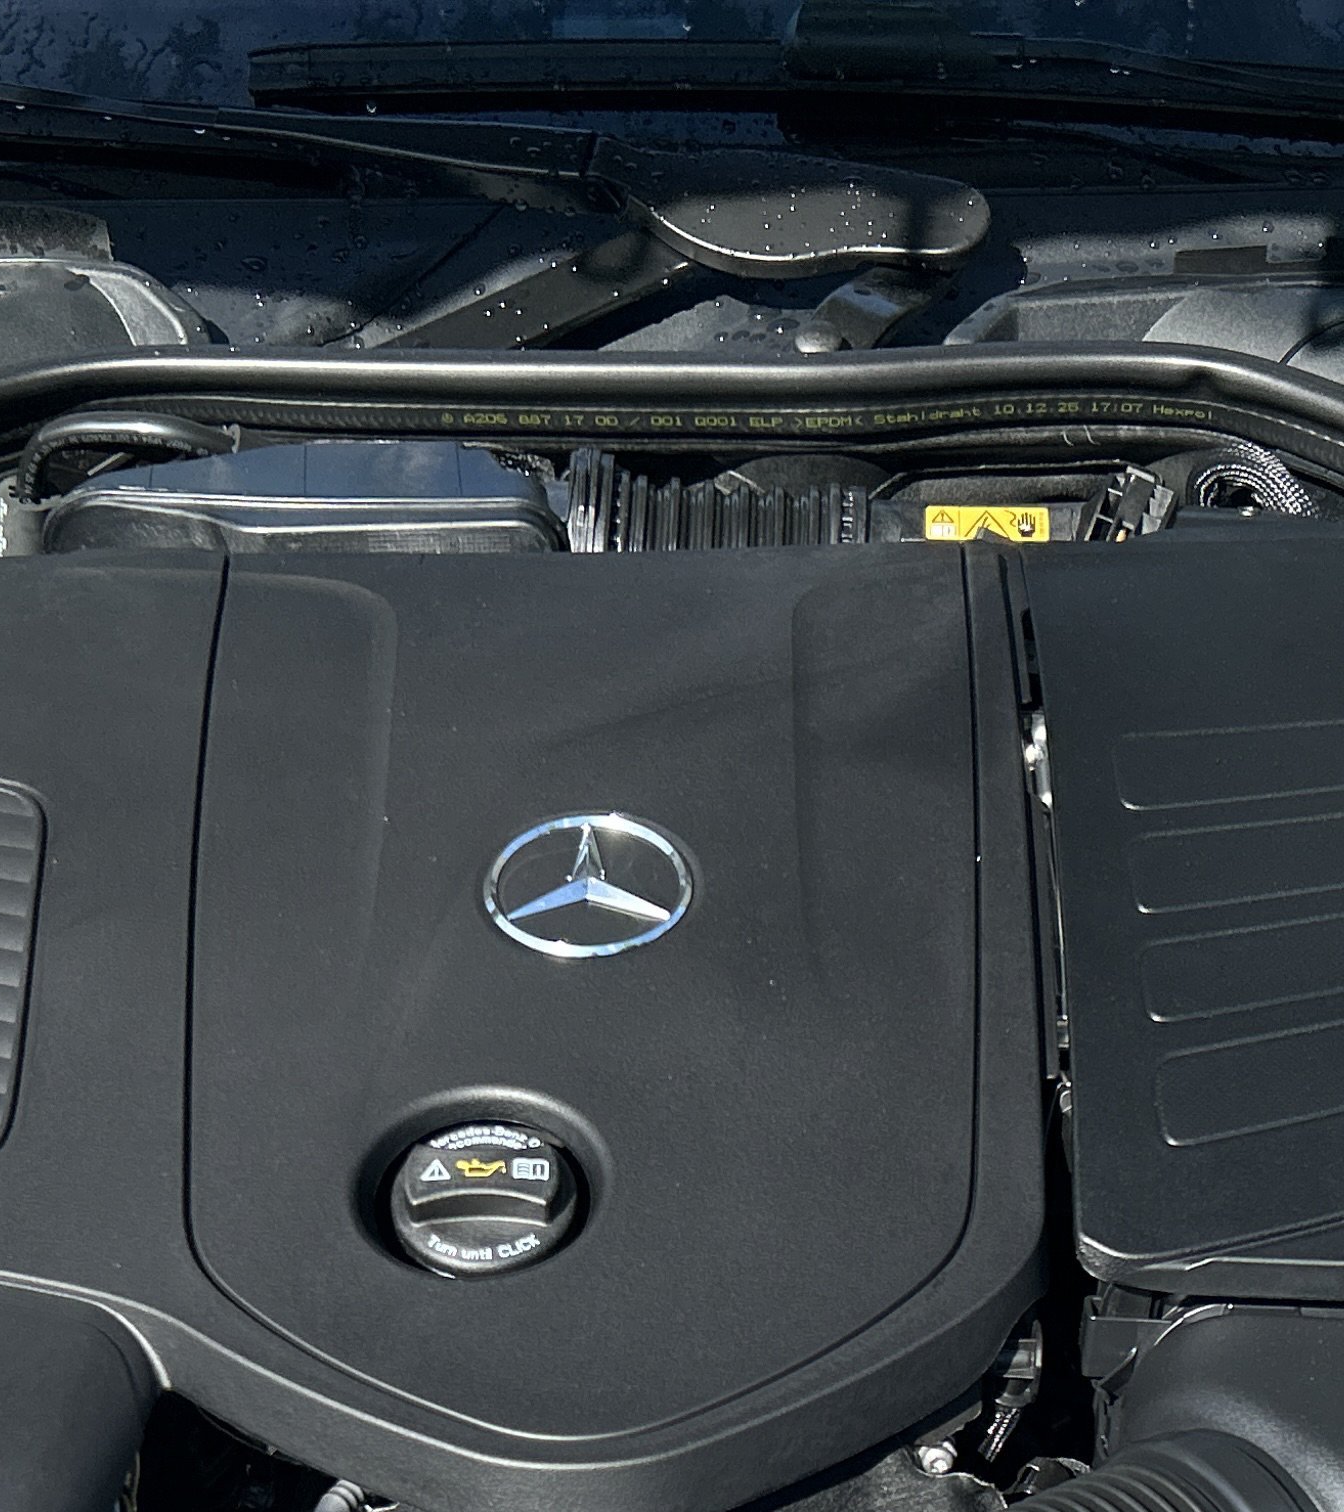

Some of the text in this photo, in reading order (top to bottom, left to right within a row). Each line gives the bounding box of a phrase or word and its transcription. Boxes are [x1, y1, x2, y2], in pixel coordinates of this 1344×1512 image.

[427, 1232, 541, 1261] Turn until CLICK
